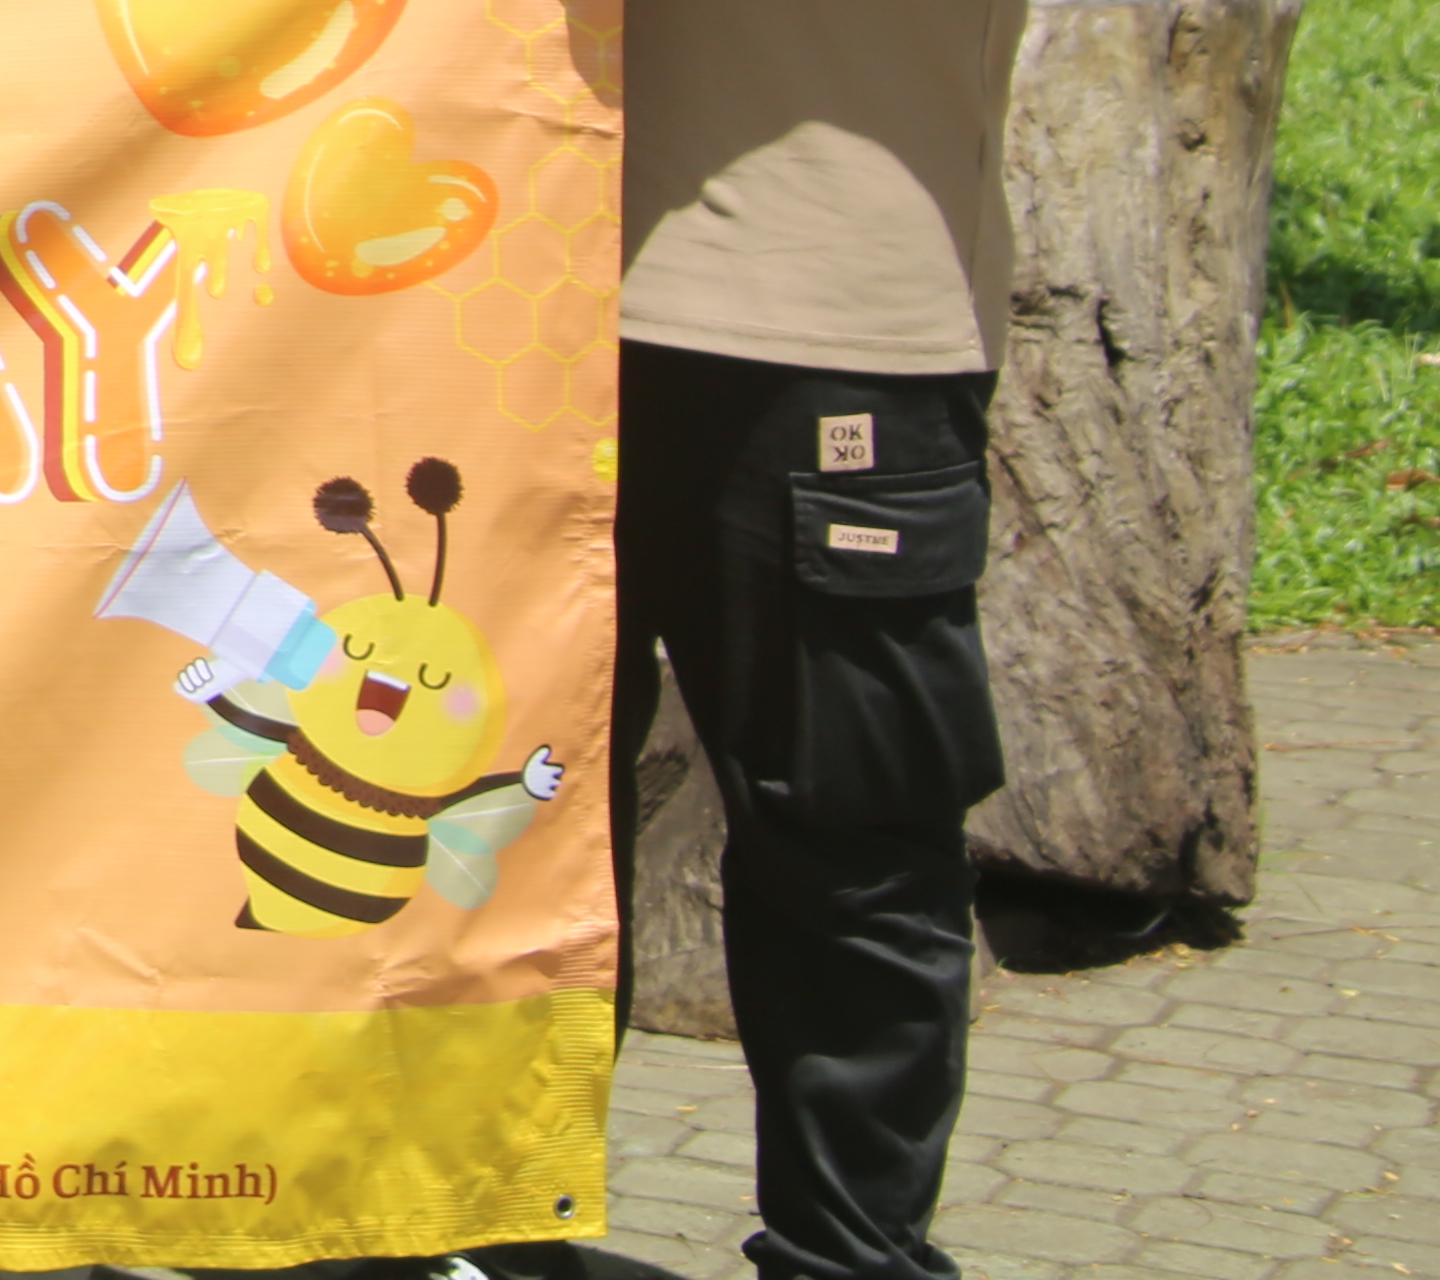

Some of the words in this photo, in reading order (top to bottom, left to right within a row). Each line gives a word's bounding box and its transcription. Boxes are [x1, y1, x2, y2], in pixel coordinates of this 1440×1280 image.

[830, 424, 863, 441] OK
[51, 1161, 128, 1197] Chí
[139, 1162, 279, 1205] Minh)
